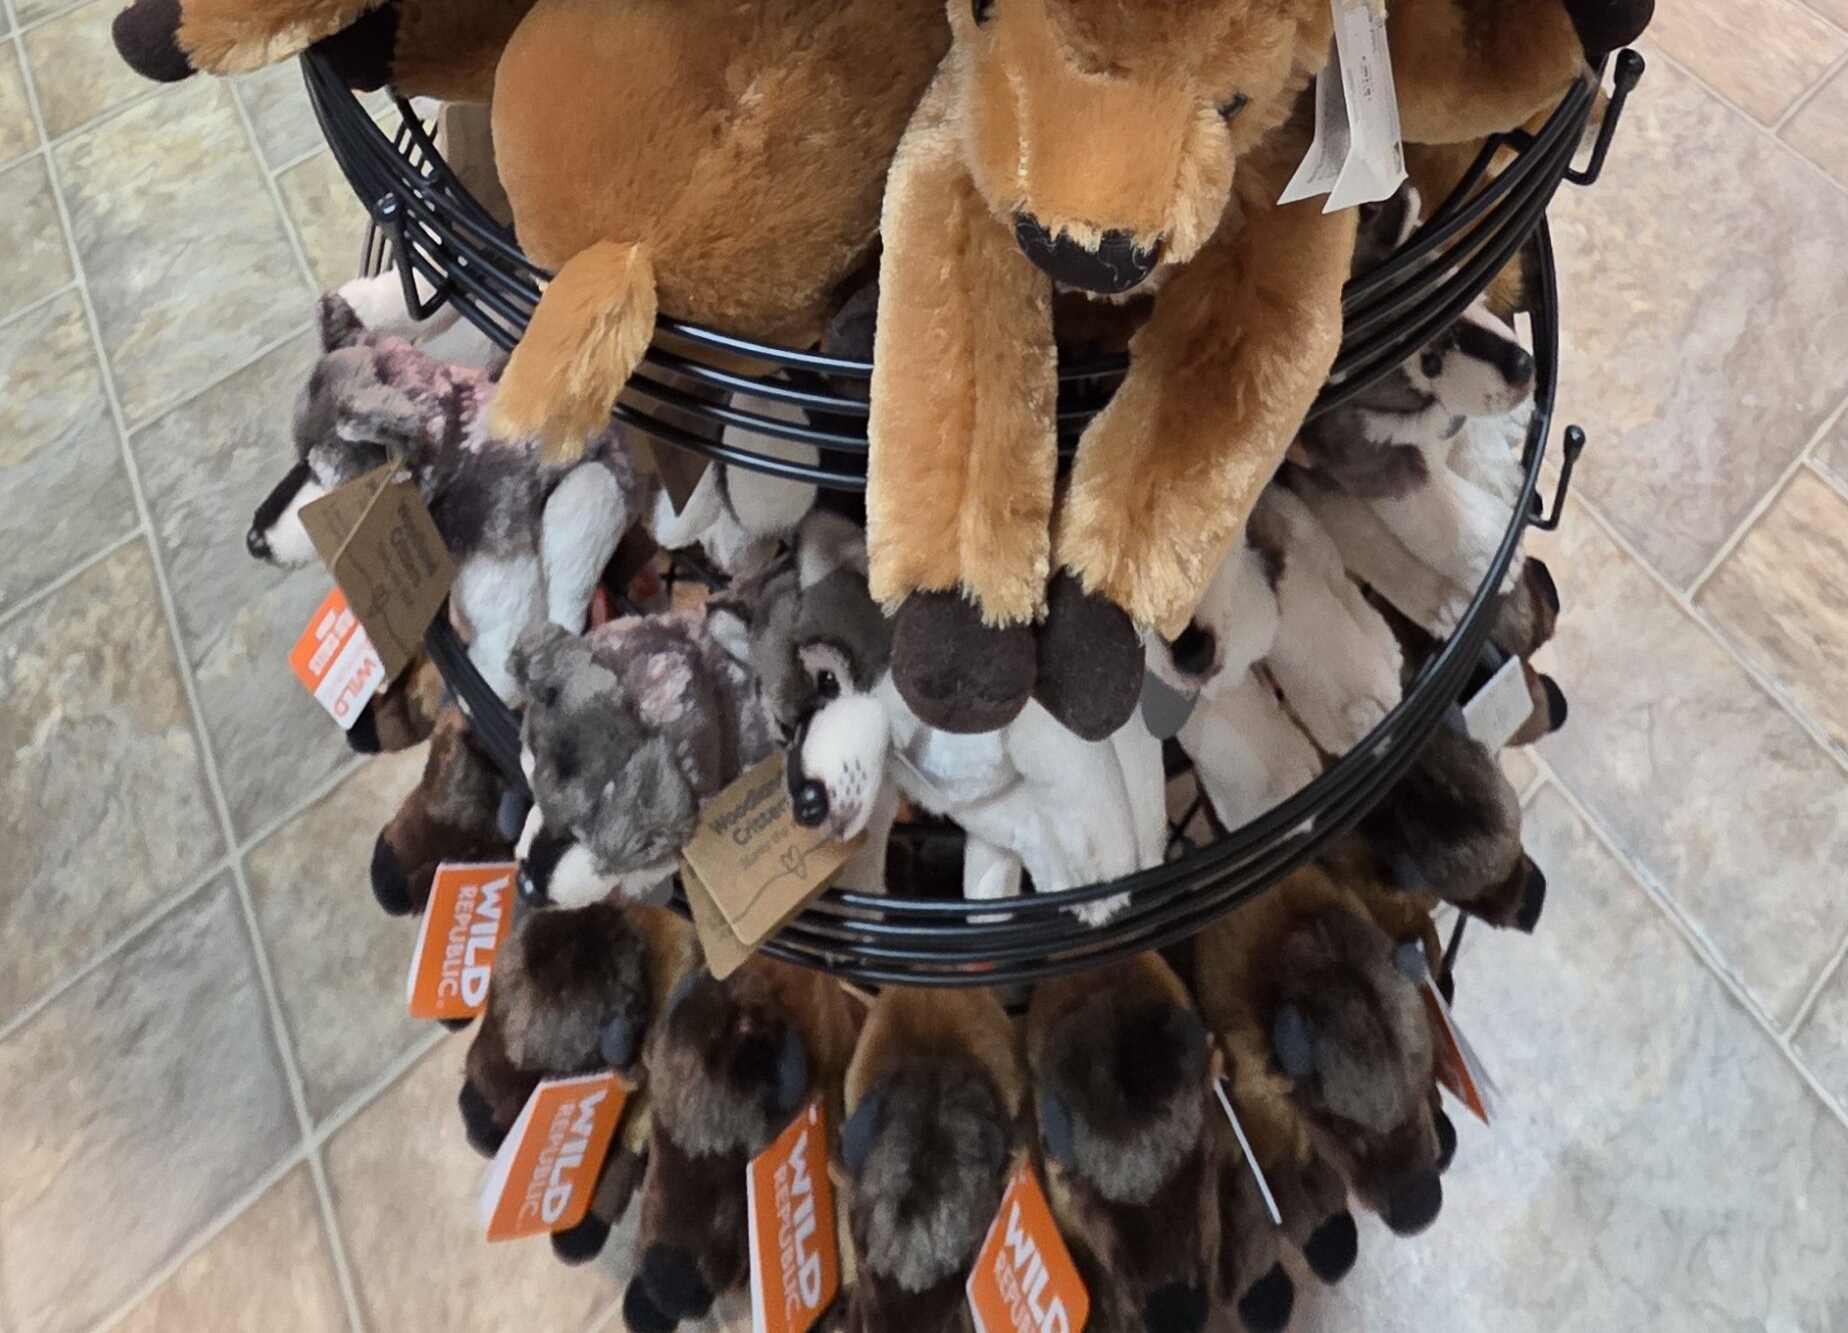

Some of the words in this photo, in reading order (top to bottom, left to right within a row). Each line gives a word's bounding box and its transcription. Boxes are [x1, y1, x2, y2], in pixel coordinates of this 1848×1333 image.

[461, 875, 510, 1008] WILD
[541, 1088, 609, 1225] WILD
[787, 1130, 821, 1309] WILD
